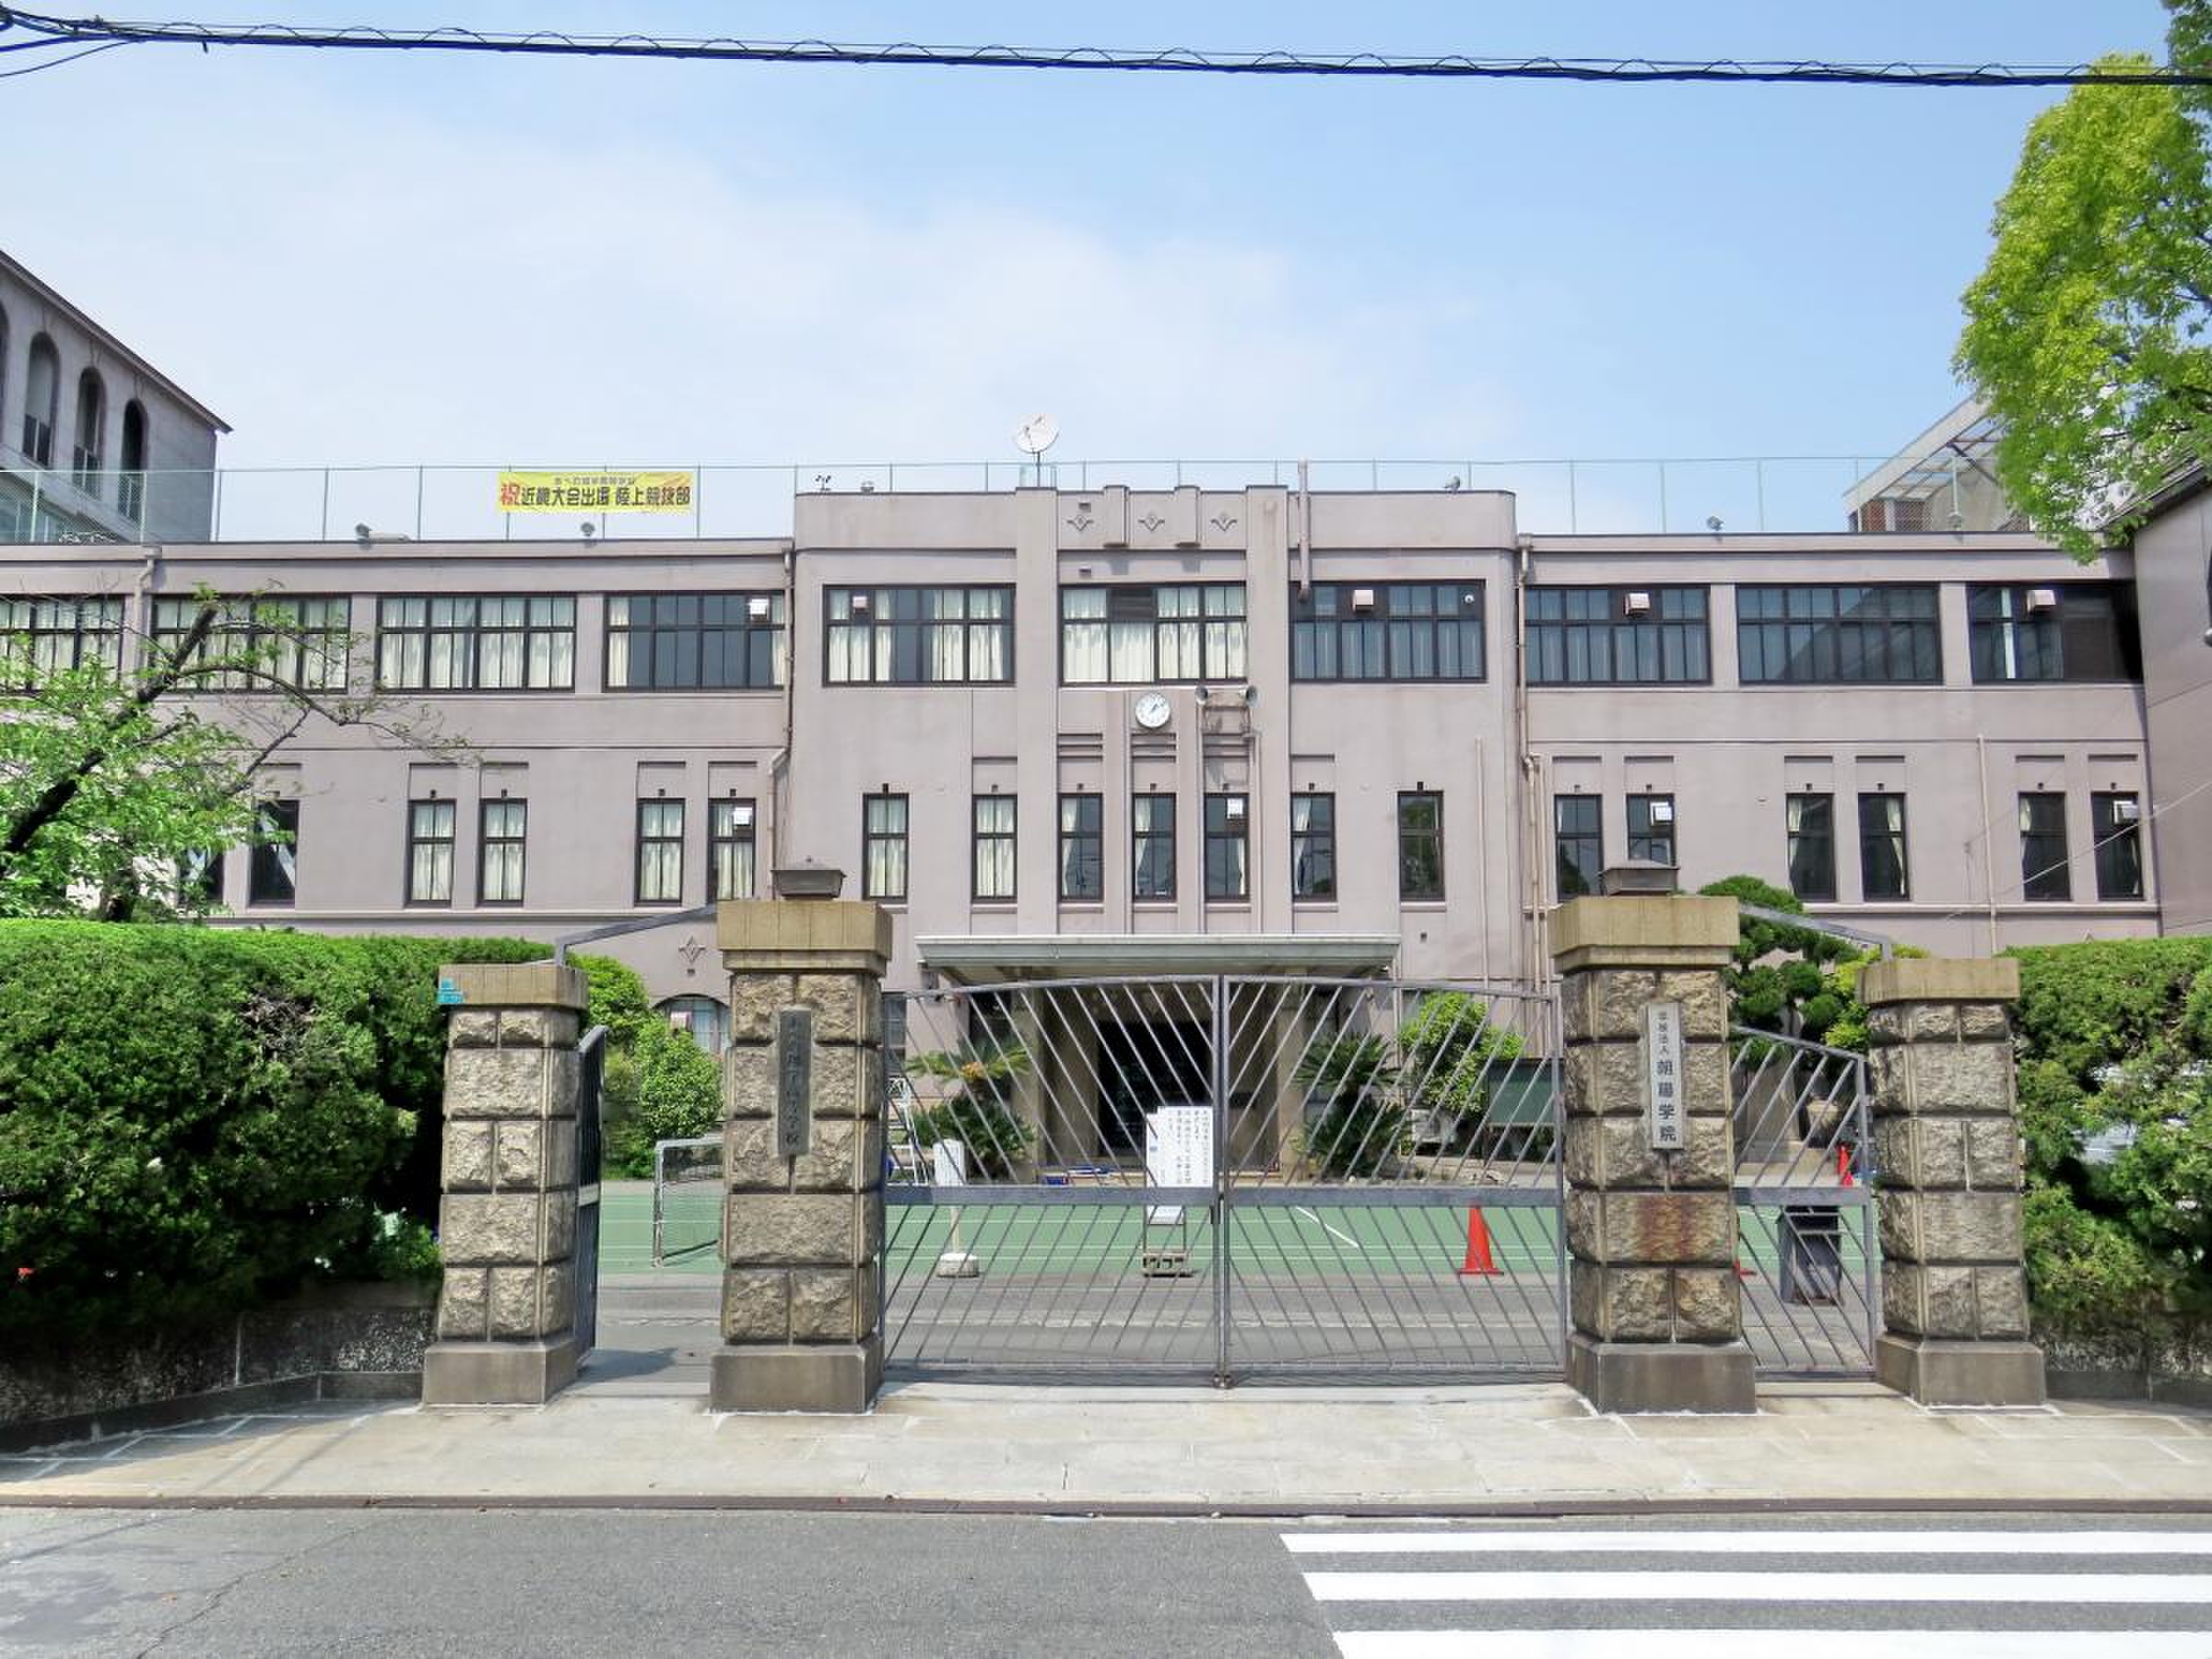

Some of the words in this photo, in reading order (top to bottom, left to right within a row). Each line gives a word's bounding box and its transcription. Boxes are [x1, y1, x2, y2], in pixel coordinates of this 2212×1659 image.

[616, 486, 690, 506] 陸上競技部
